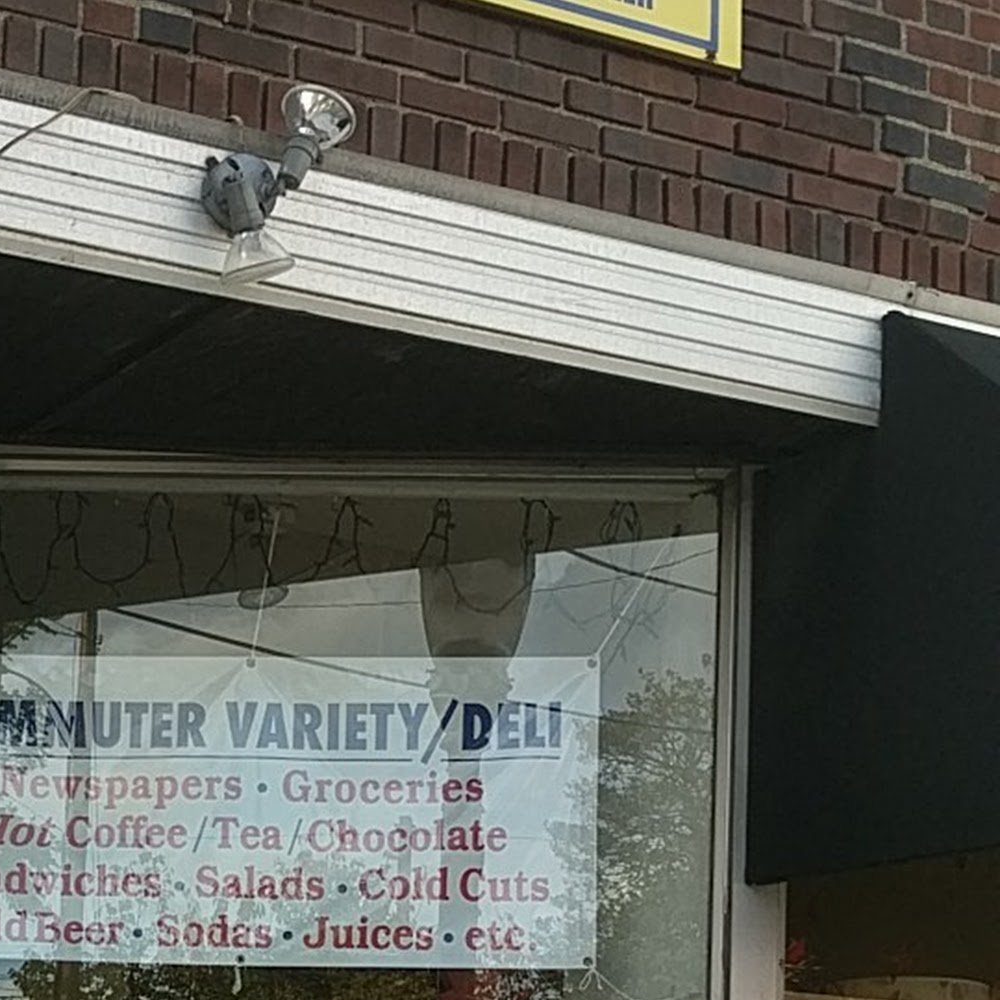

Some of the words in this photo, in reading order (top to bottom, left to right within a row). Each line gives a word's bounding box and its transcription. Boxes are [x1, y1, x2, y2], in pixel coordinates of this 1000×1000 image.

[226, 698, 562, 764] VARIETY/DELI
[1, 768, 243, 809] Newspapers
[282, 769, 484, 803] Groceries
[195, 865, 325, 900] Salads
[358, 866, 449, 901] Cold
[459, 867, 550, 902] Cuts
[34, 911, 125, 945] Beer
[156, 913, 274, 949] Sodas
[303, 915, 434, 950] Juices
